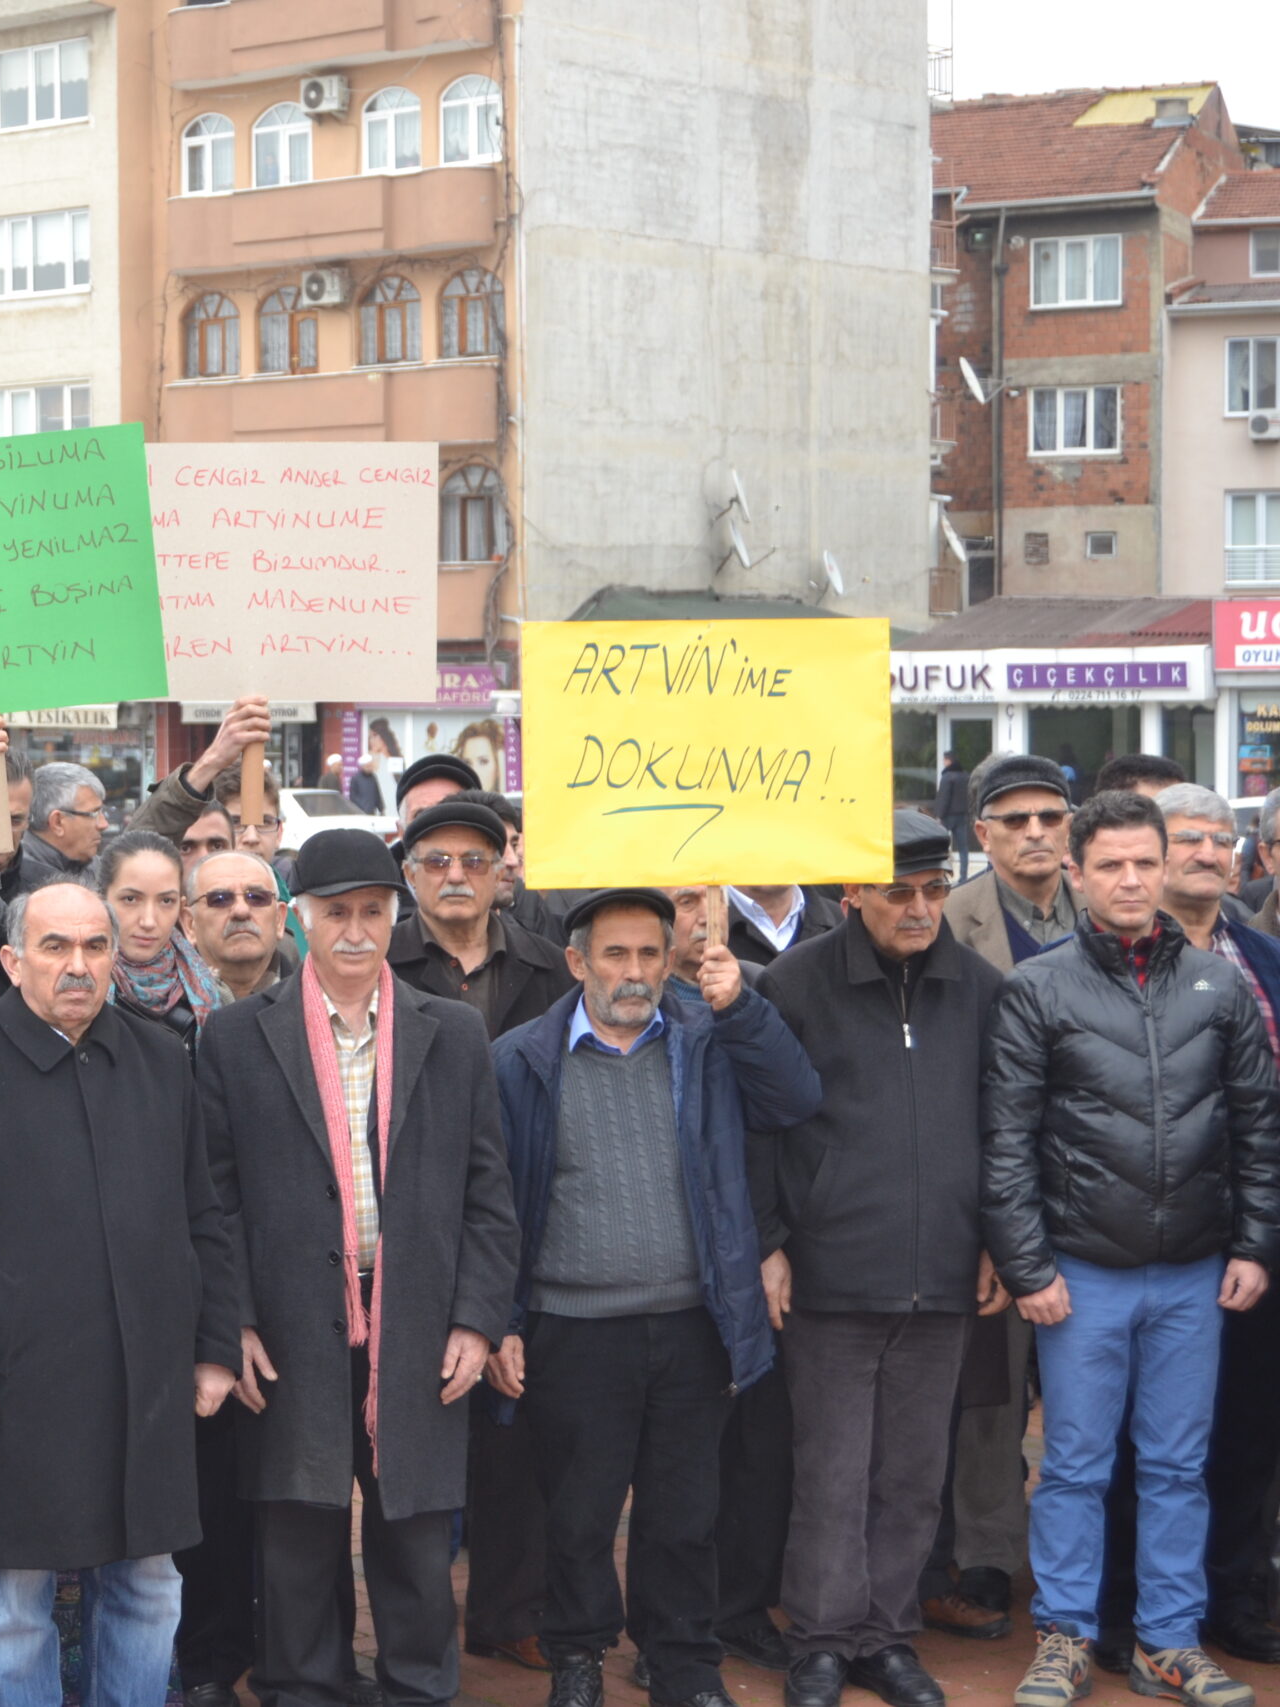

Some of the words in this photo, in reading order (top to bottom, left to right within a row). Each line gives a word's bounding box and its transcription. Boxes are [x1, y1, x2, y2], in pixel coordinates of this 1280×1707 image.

[898, 663, 993, 692] UFUK
[1012, 663, 1182, 688] ÇİÇEKÇİLİK
[1068, 690, 1093, 700] 0224
